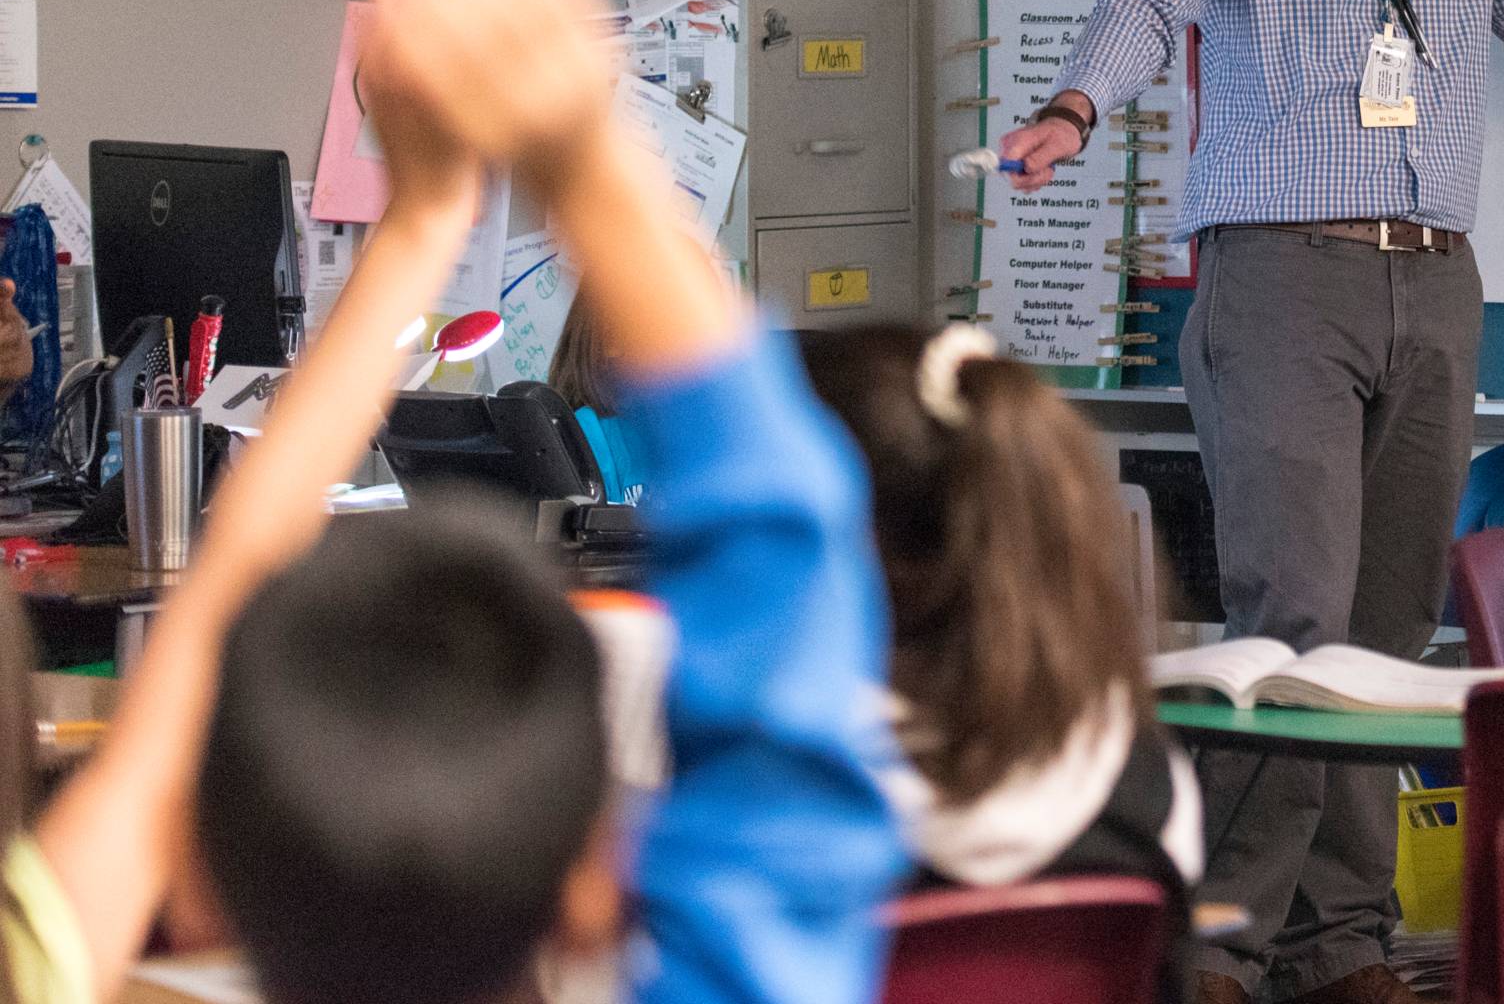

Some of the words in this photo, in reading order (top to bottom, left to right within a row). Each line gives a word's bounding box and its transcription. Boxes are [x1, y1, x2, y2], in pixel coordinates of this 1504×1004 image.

[1021, 13, 1072, 22] Classroom
[815, 45, 850, 70] Math
[1021, 55, 1060, 66] Morning
[1013, 75, 1053, 84] Teacher
[1010, 197, 1037, 206] Table
[1041, 198, 1083, 207] Washers
[1086, 199, 1099, 209] (2)
[1017, 218, 1045, 227] Trash
[1048, 219, 1091, 230] Manager
[1020, 239, 1068, 248] Librarians
[1072, 240, 1085, 251] (2)
[1010, 259, 1057, 270] Computer
[1060, 260, 1092, 271] Helper
[1015, 279, 1039, 288] Floor
[1042, 280, 1084, 292] Manager
[1023, 300, 1073, 310] Substitute
[1048, 344, 1080, 361] Helper
